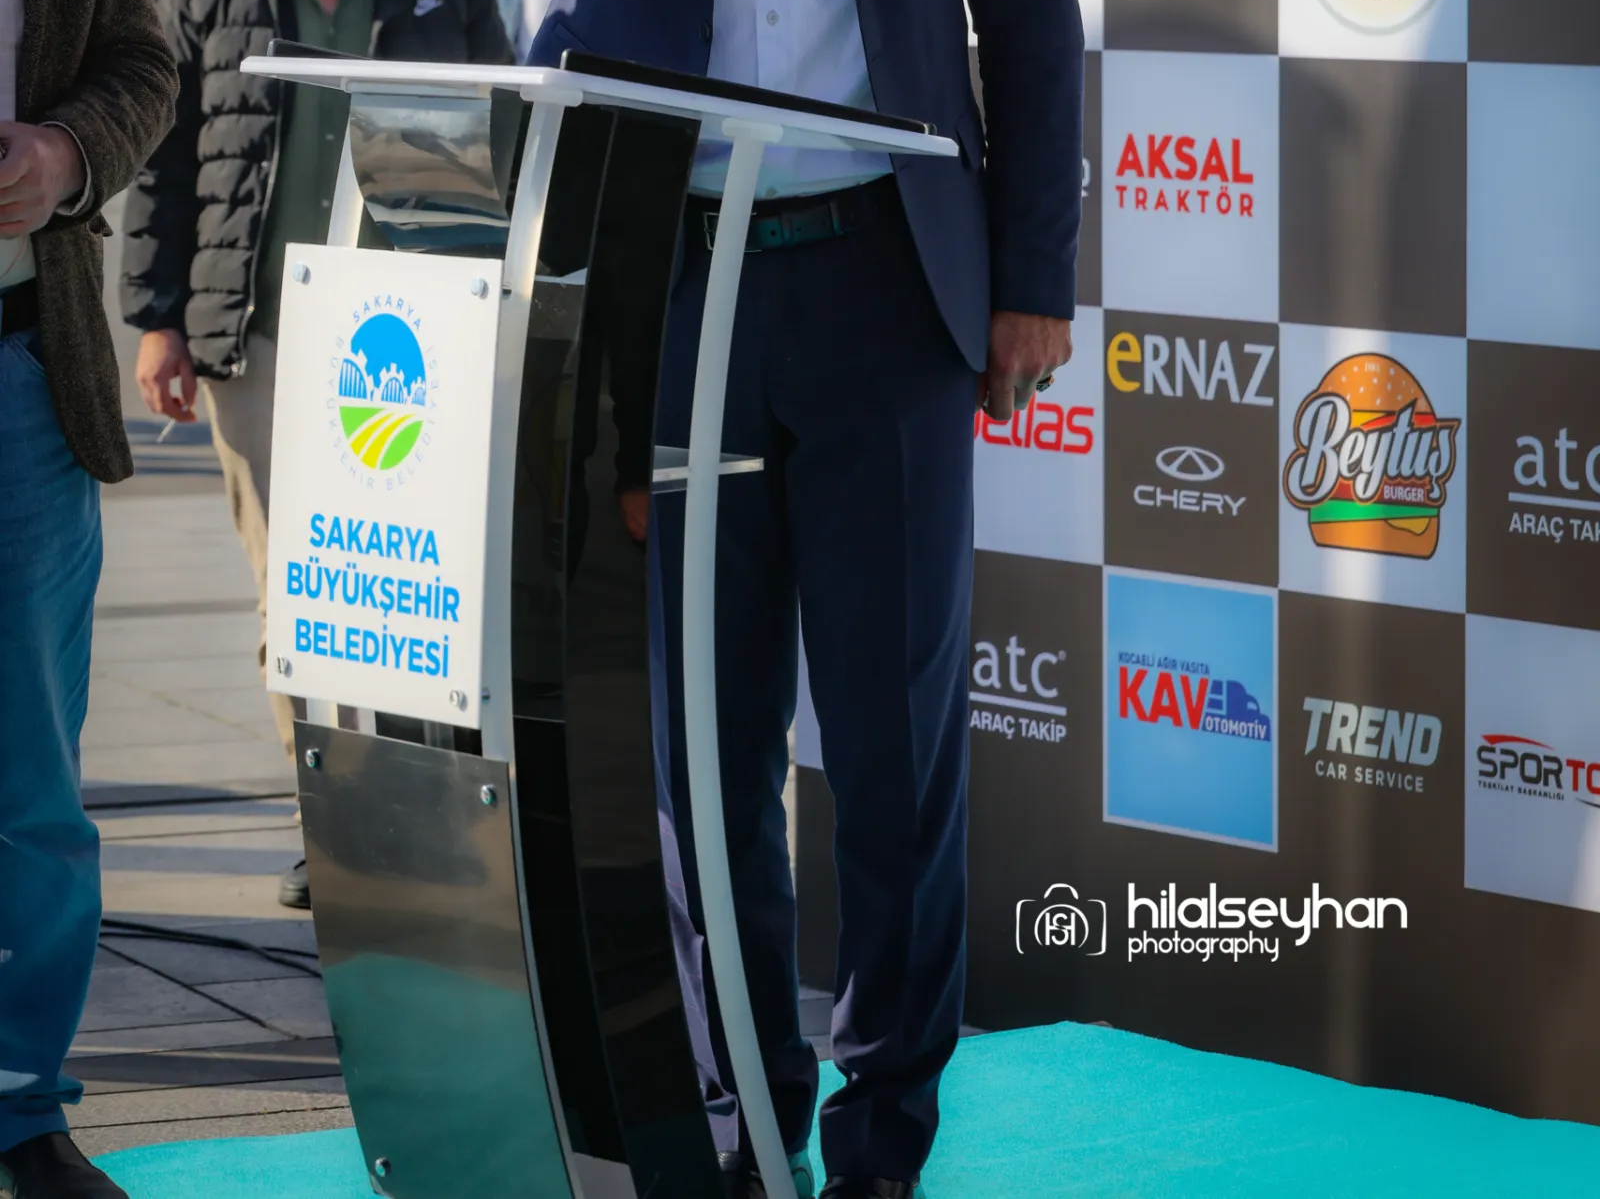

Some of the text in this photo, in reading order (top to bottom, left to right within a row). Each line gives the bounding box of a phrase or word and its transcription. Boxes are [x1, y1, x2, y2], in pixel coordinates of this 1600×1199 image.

[1115, 133, 1254, 184] AKSAL
[1115, 185, 1254, 217] TRAKTÖR
[1106, 332, 1275, 406] eRNAZ
[973, 390, 1095, 455] etlas
[1133, 484, 1246, 516] CHERY
[1383, 485, 1424, 503] BURGER
[308, 513, 440, 566] SAKARYA
[1508, 511, 1565, 544] ARAÇ
[286, 556, 460, 623] BÜYÜKŞEHİR
[294, 618, 449, 678] BELEDİYESİ
[1119, 666, 1209, 731] KAV
[969, 709, 1067, 743] ARAÇ TAKİP
[1204, 715, 1268, 740] OTOMOTİV
[1302, 696, 1443, 767] TREND
[1315, 759, 1425, 794] CAR SERVICE
